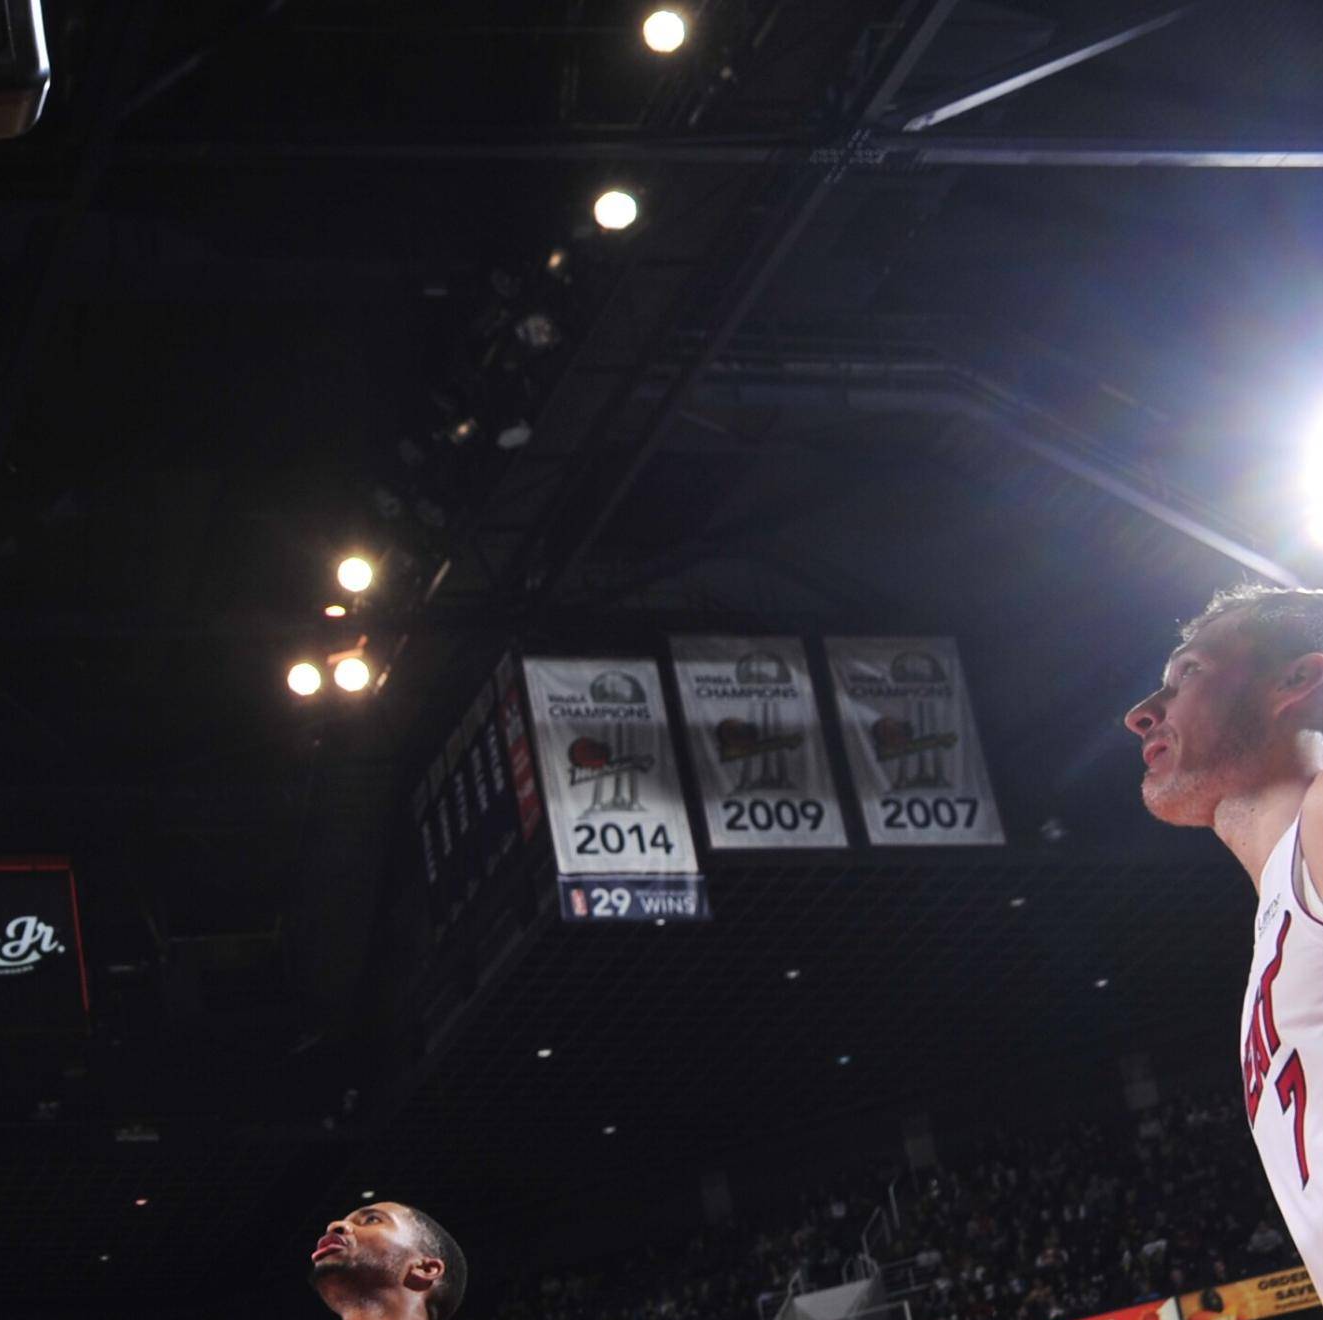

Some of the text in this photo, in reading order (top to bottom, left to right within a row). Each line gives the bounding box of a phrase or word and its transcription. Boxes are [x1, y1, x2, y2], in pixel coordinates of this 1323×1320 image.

[549, 704, 651, 720] CHAMPIONS
[722, 798, 825, 832] 2009
[880, 798, 979, 829] 2007
[573, 823, 674, 855] 2014
[590, 888, 697, 918] 29 WINS
[2, 916, 66, 959] Jr.
[1275, 1048, 1309, 1191] 7
